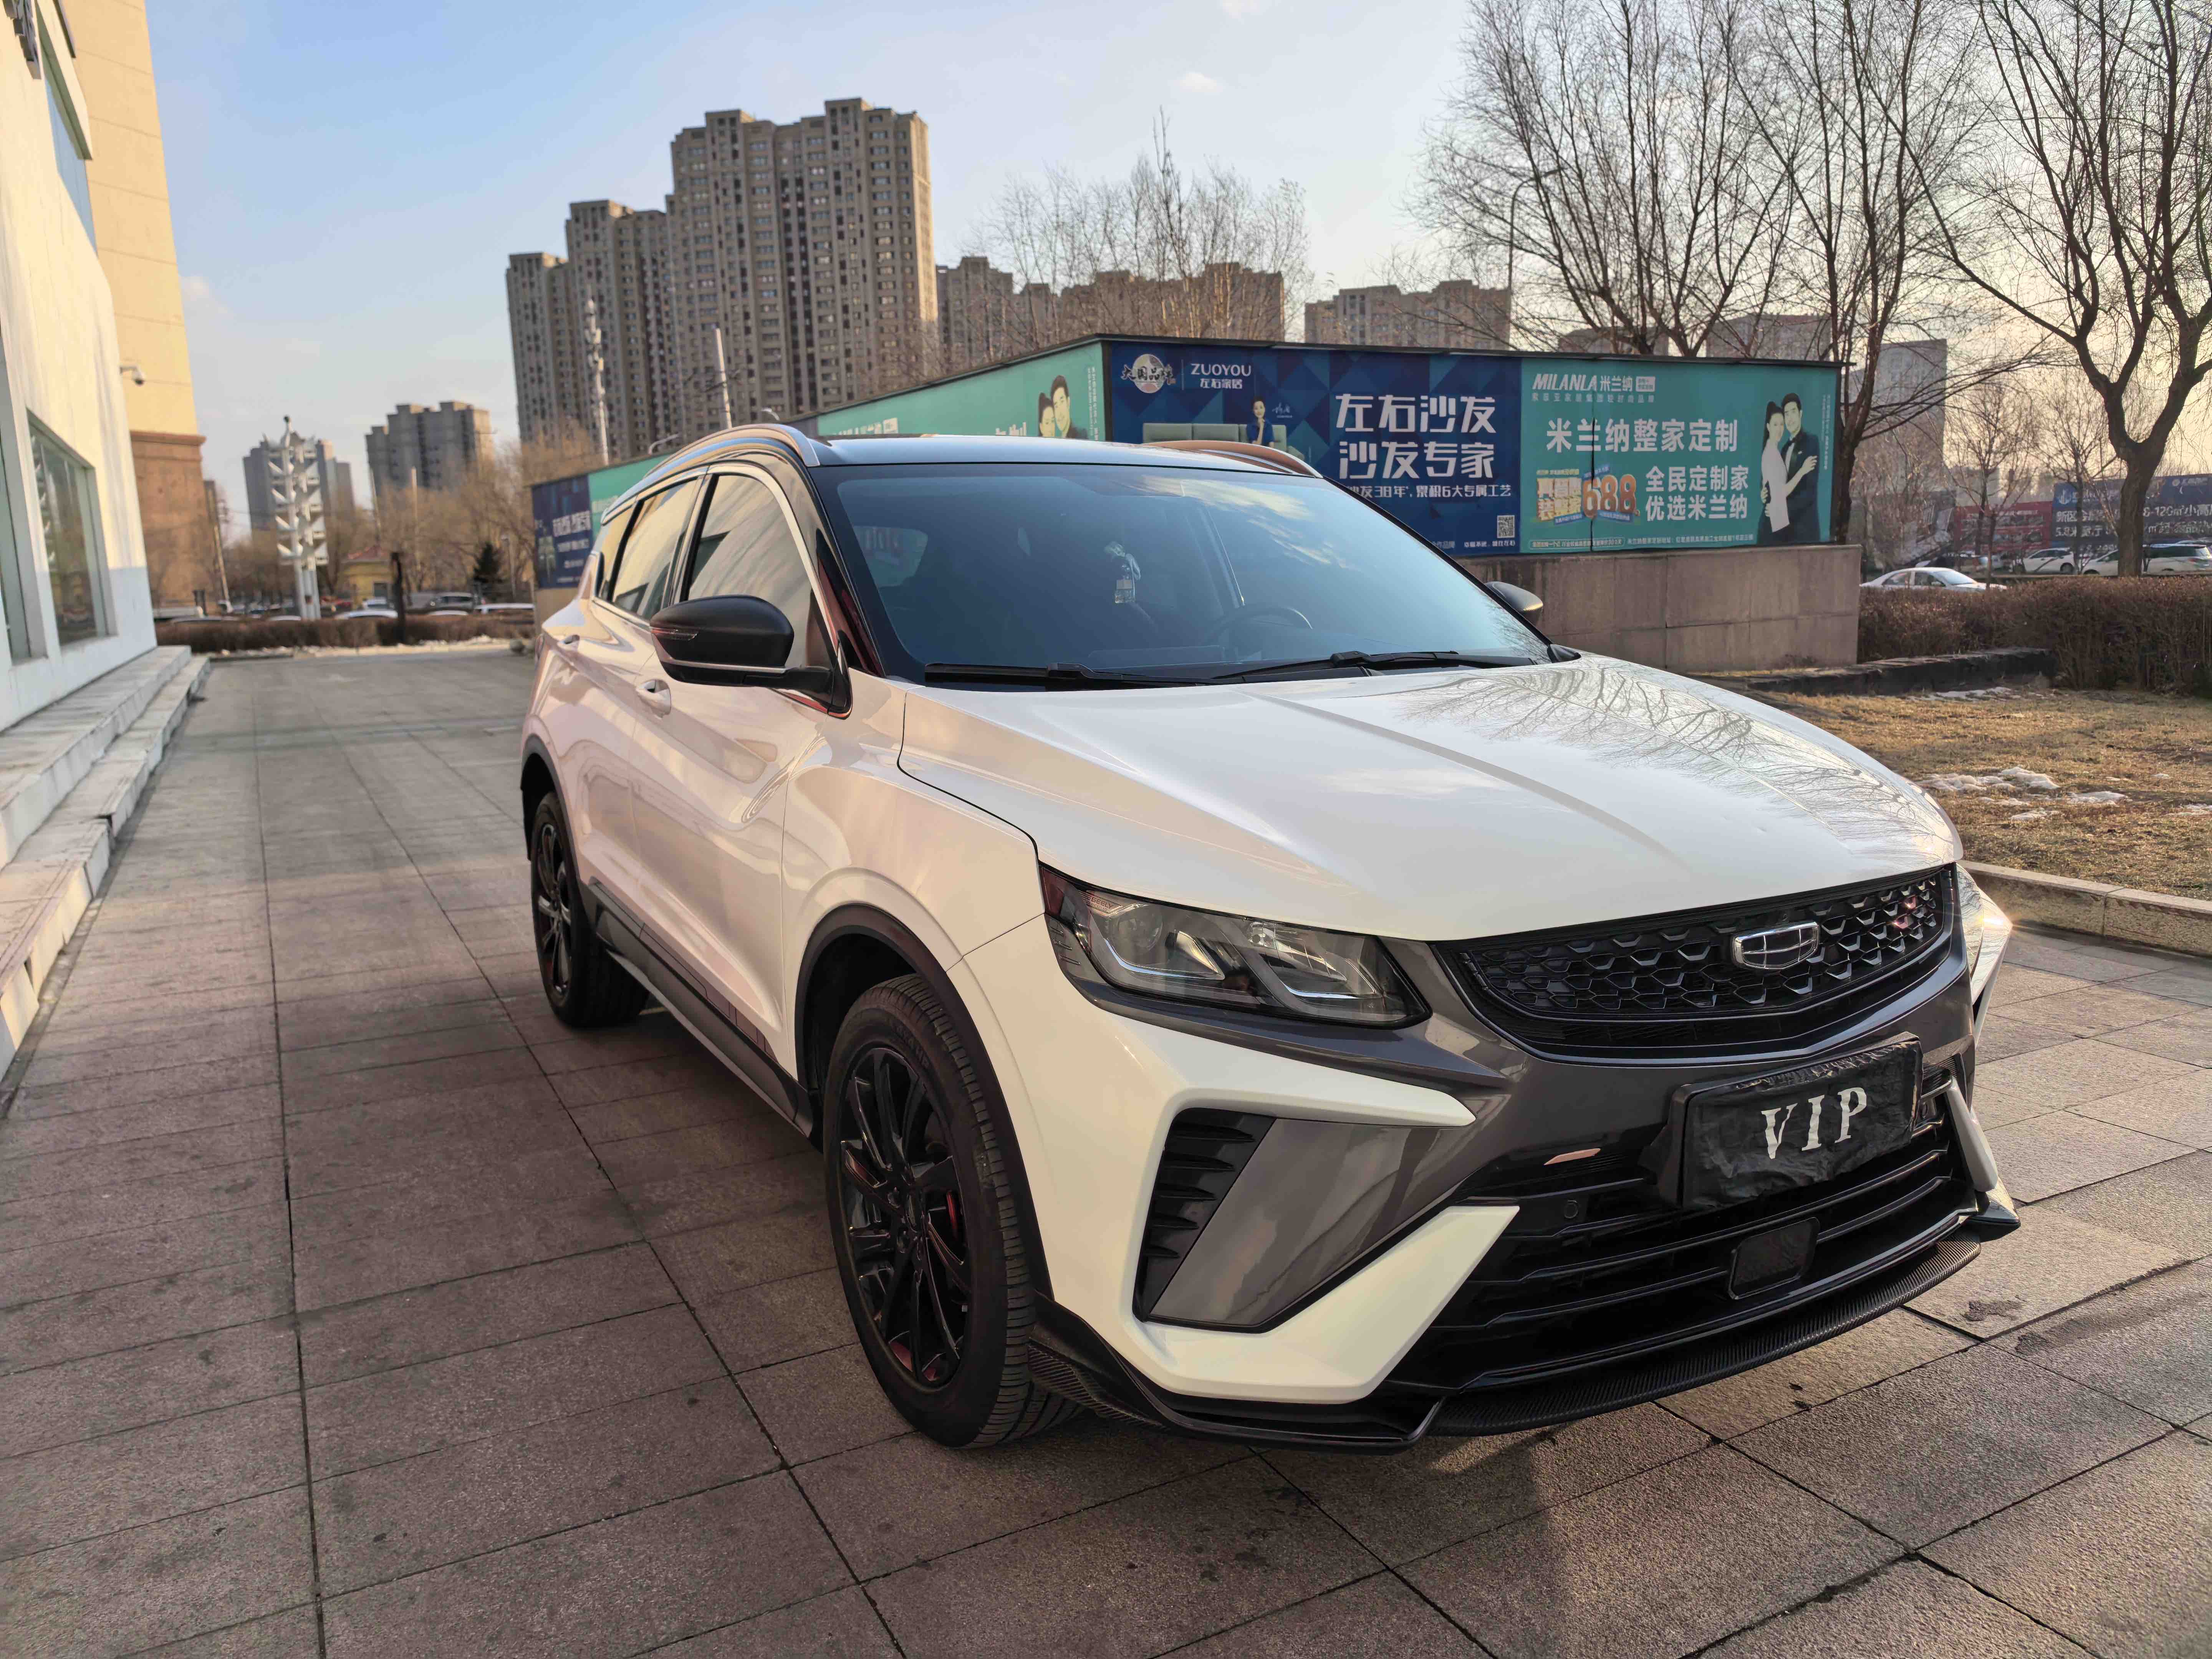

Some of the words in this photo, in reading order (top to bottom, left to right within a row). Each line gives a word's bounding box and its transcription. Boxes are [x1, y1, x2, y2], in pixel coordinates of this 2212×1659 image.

[1190, 363, 1252, 377] ZUOYOU
[1532, 374, 1597, 391] MILANLA
[1600, 375, 1633, 392] 米兰纳
[1336, 394, 1497, 433] 左右沙发
[1546, 417, 1738, 453] 米兰纳整家定制
[1339, 441, 1495, 479] 沙发专家
[1646, 465, 1749, 492] 全民定制家
[1583, 474, 1637, 518] 688
[1646, 494, 1748, 522] 优选米兰纳
[1091, 897, 1114, 909] GEELY
[1761, 1087, 1867, 1159] VIP
